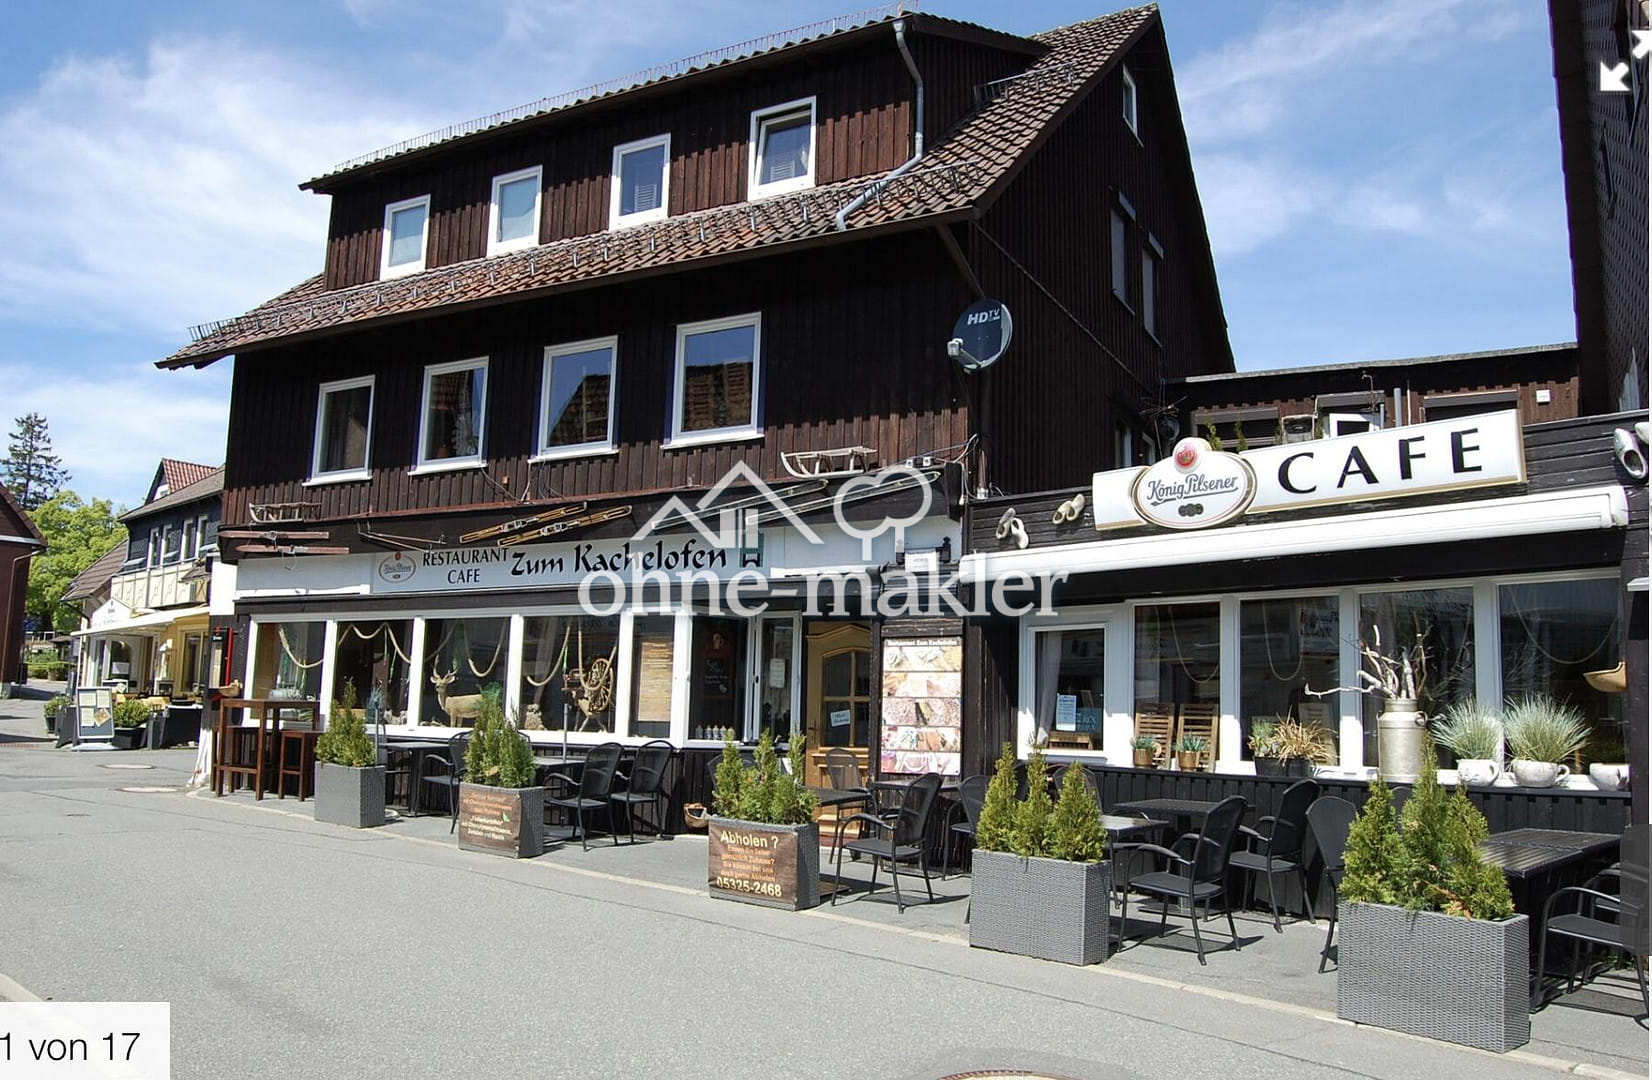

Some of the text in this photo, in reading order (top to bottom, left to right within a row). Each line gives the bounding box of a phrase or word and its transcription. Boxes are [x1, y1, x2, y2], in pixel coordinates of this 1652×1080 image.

[1277, 427, 1482, 494] CAFE
[1146, 473, 1239, 499] König Pilsener
[422, 547, 509, 567] RESTAURANT
[510, 538, 727, 576] Zum Kachelofen
[447, 568, 480, 584] CAFE
[720, 830, 779, 849] Abholen ?
[716, 876, 782, 897] 05325-2468
